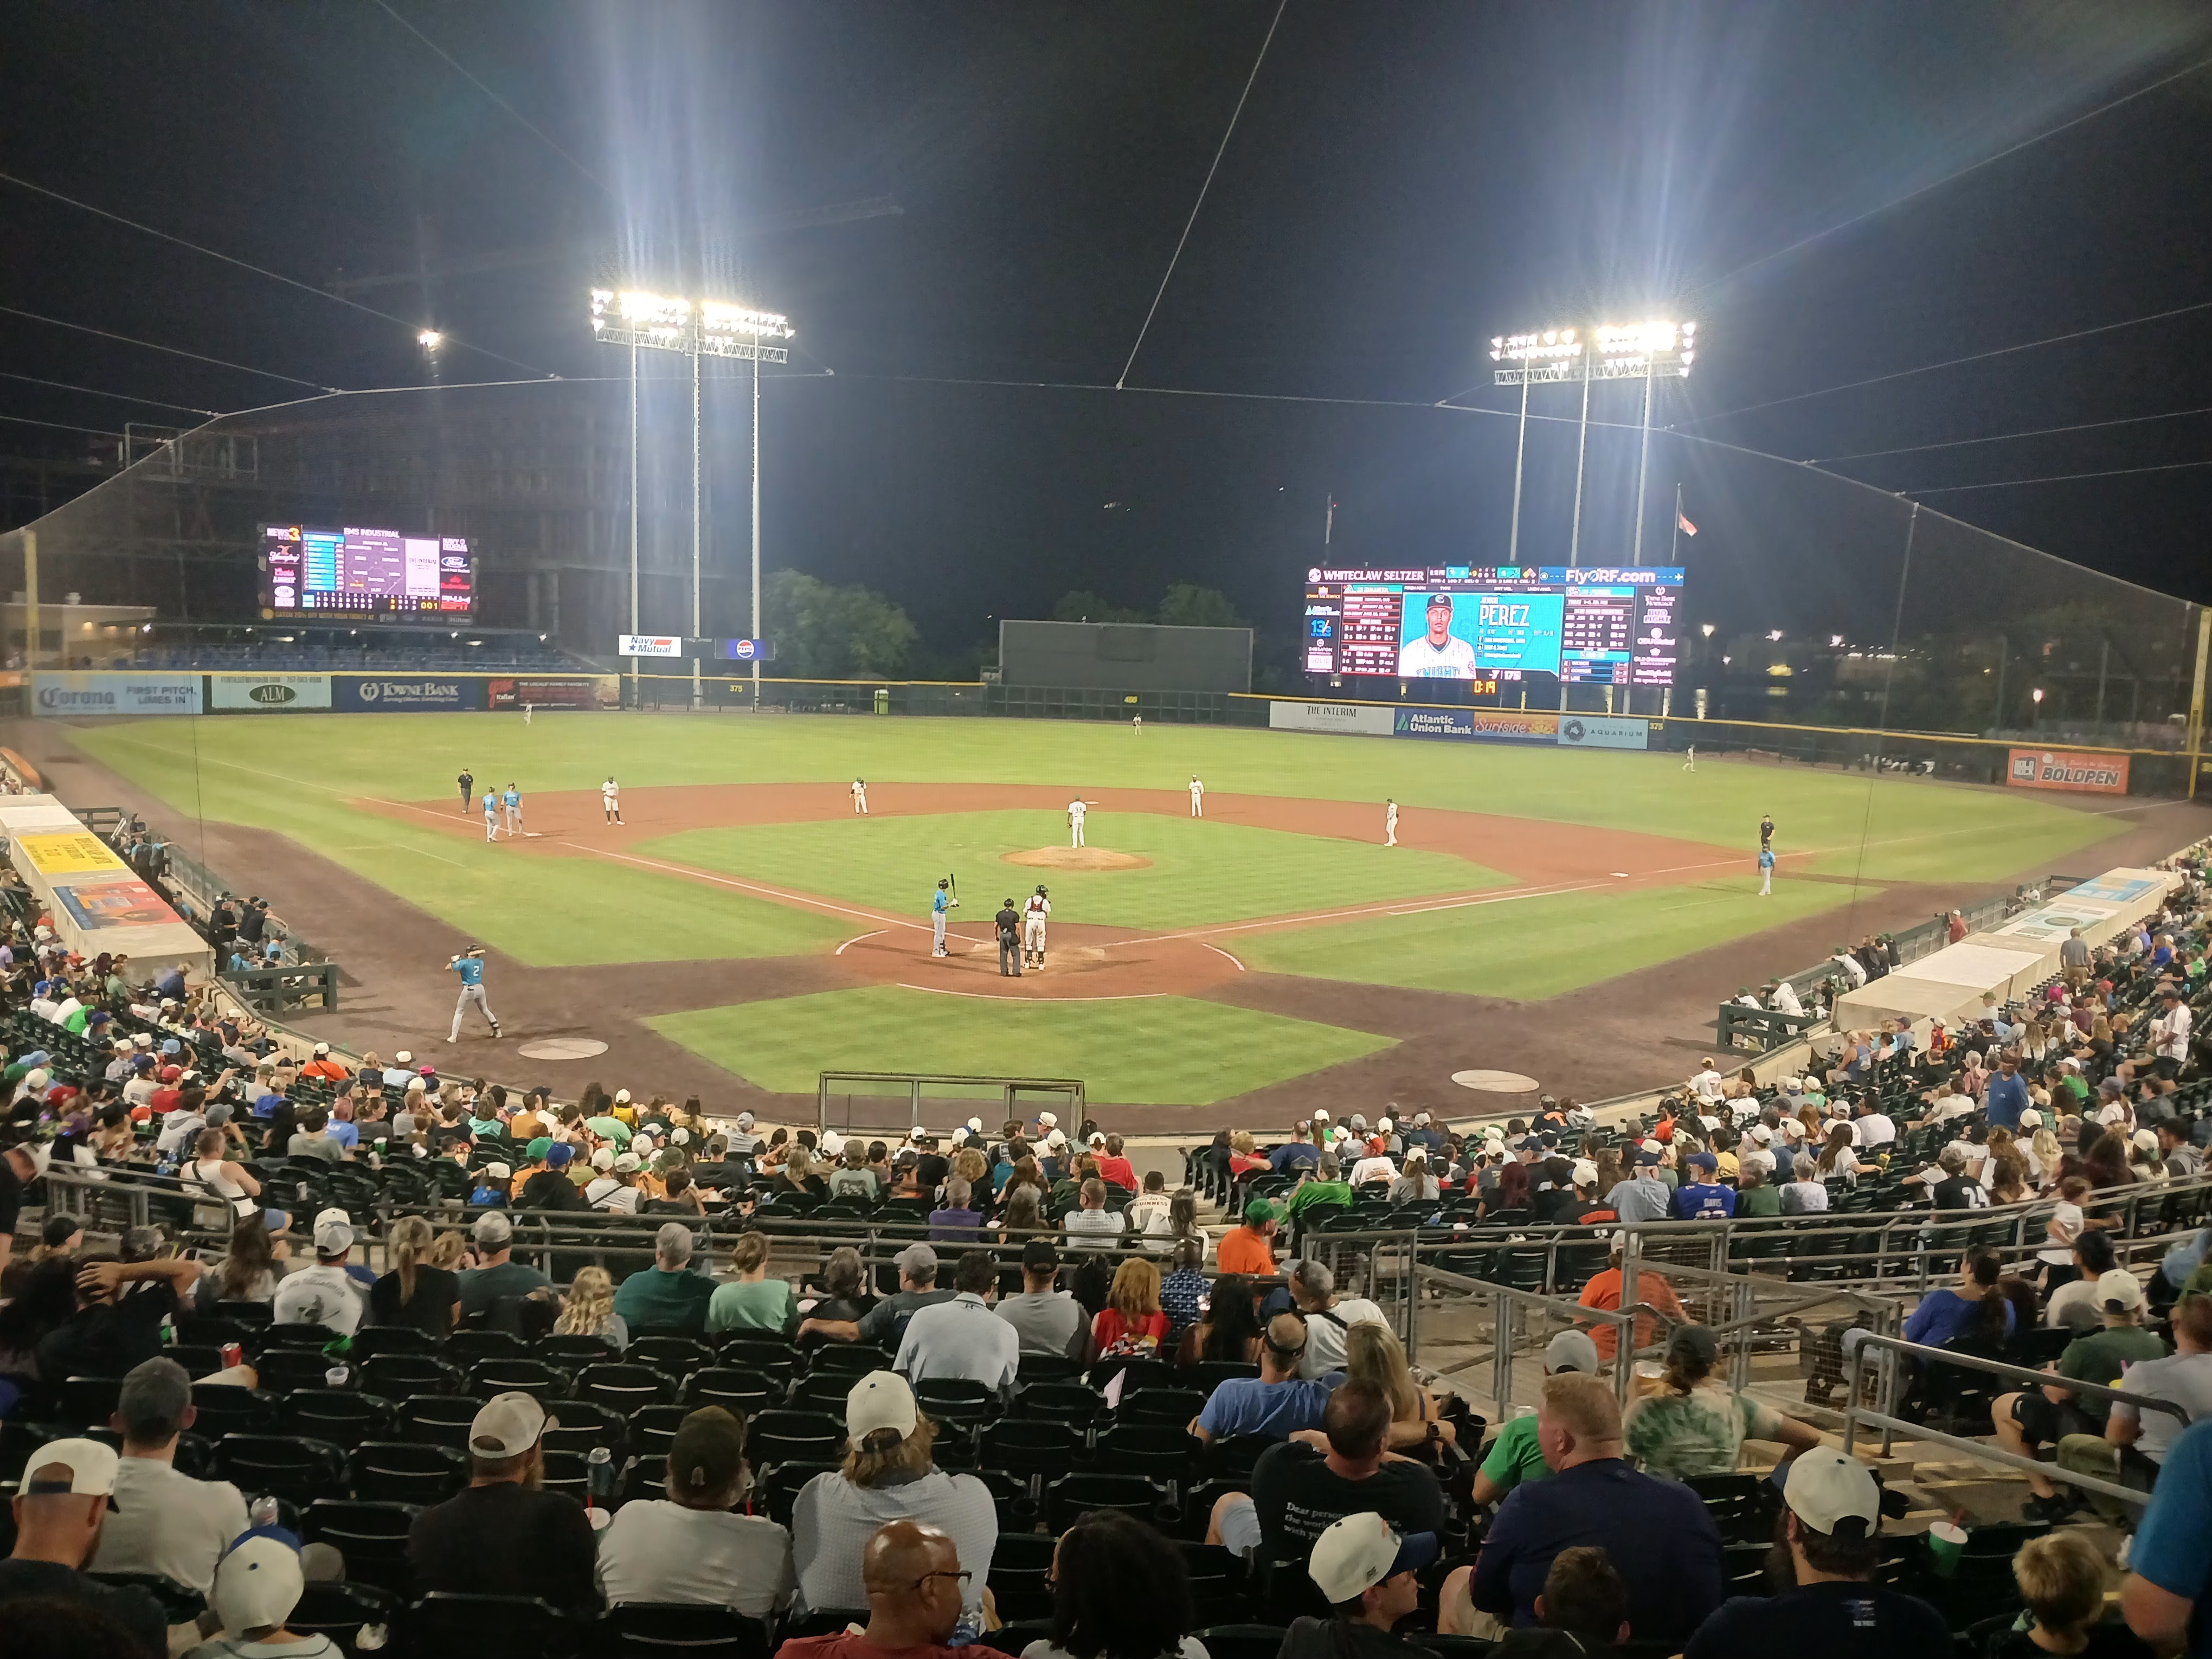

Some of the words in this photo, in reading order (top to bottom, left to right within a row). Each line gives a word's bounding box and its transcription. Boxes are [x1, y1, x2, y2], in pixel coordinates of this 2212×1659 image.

[288, 528, 300, 542] 3
[361, 529, 400, 538] INDUSTRIAL
[1323, 570, 1382, 581] WHITECLAW
[1384, 570, 1424, 581] SELTZER
[1479, 605, 1530, 627] PEREZ
[631, 636, 655, 646] Navy
[126, 686, 158, 695] FIRST
[161, 686, 197, 695] PITCH,
[730, 685, 743, 693] 375
[1474, 680, 1495, 693] 0:19
[38, 687, 115, 708] Corona
[260, 687, 285, 702] ALM
[1307, 705, 1320, 715] THE
[1323, 706, 1356, 717] INTERIM
[1411, 714, 1454, 724] Atlantic
[1410, 723, 1442, 733] Union
[1444, 724, 1471, 735] Bank
[1475, 718, 1527, 734] Surfside
[2041, 767, 2120, 786] BOLDPEN
[473, 966, 479, 976] 2
[1703, 1198, 1722, 1207] DAVIS
[1962, 1186, 1991, 1208] 24
[1286, 1501, 1310, 1515] Dear
[1311, 1509, 1344, 1519] person
[1285, 1514, 1301, 1525] the
[1284, 1524, 1306, 1536] with
[1308, 1531, 1321, 1540] yo
